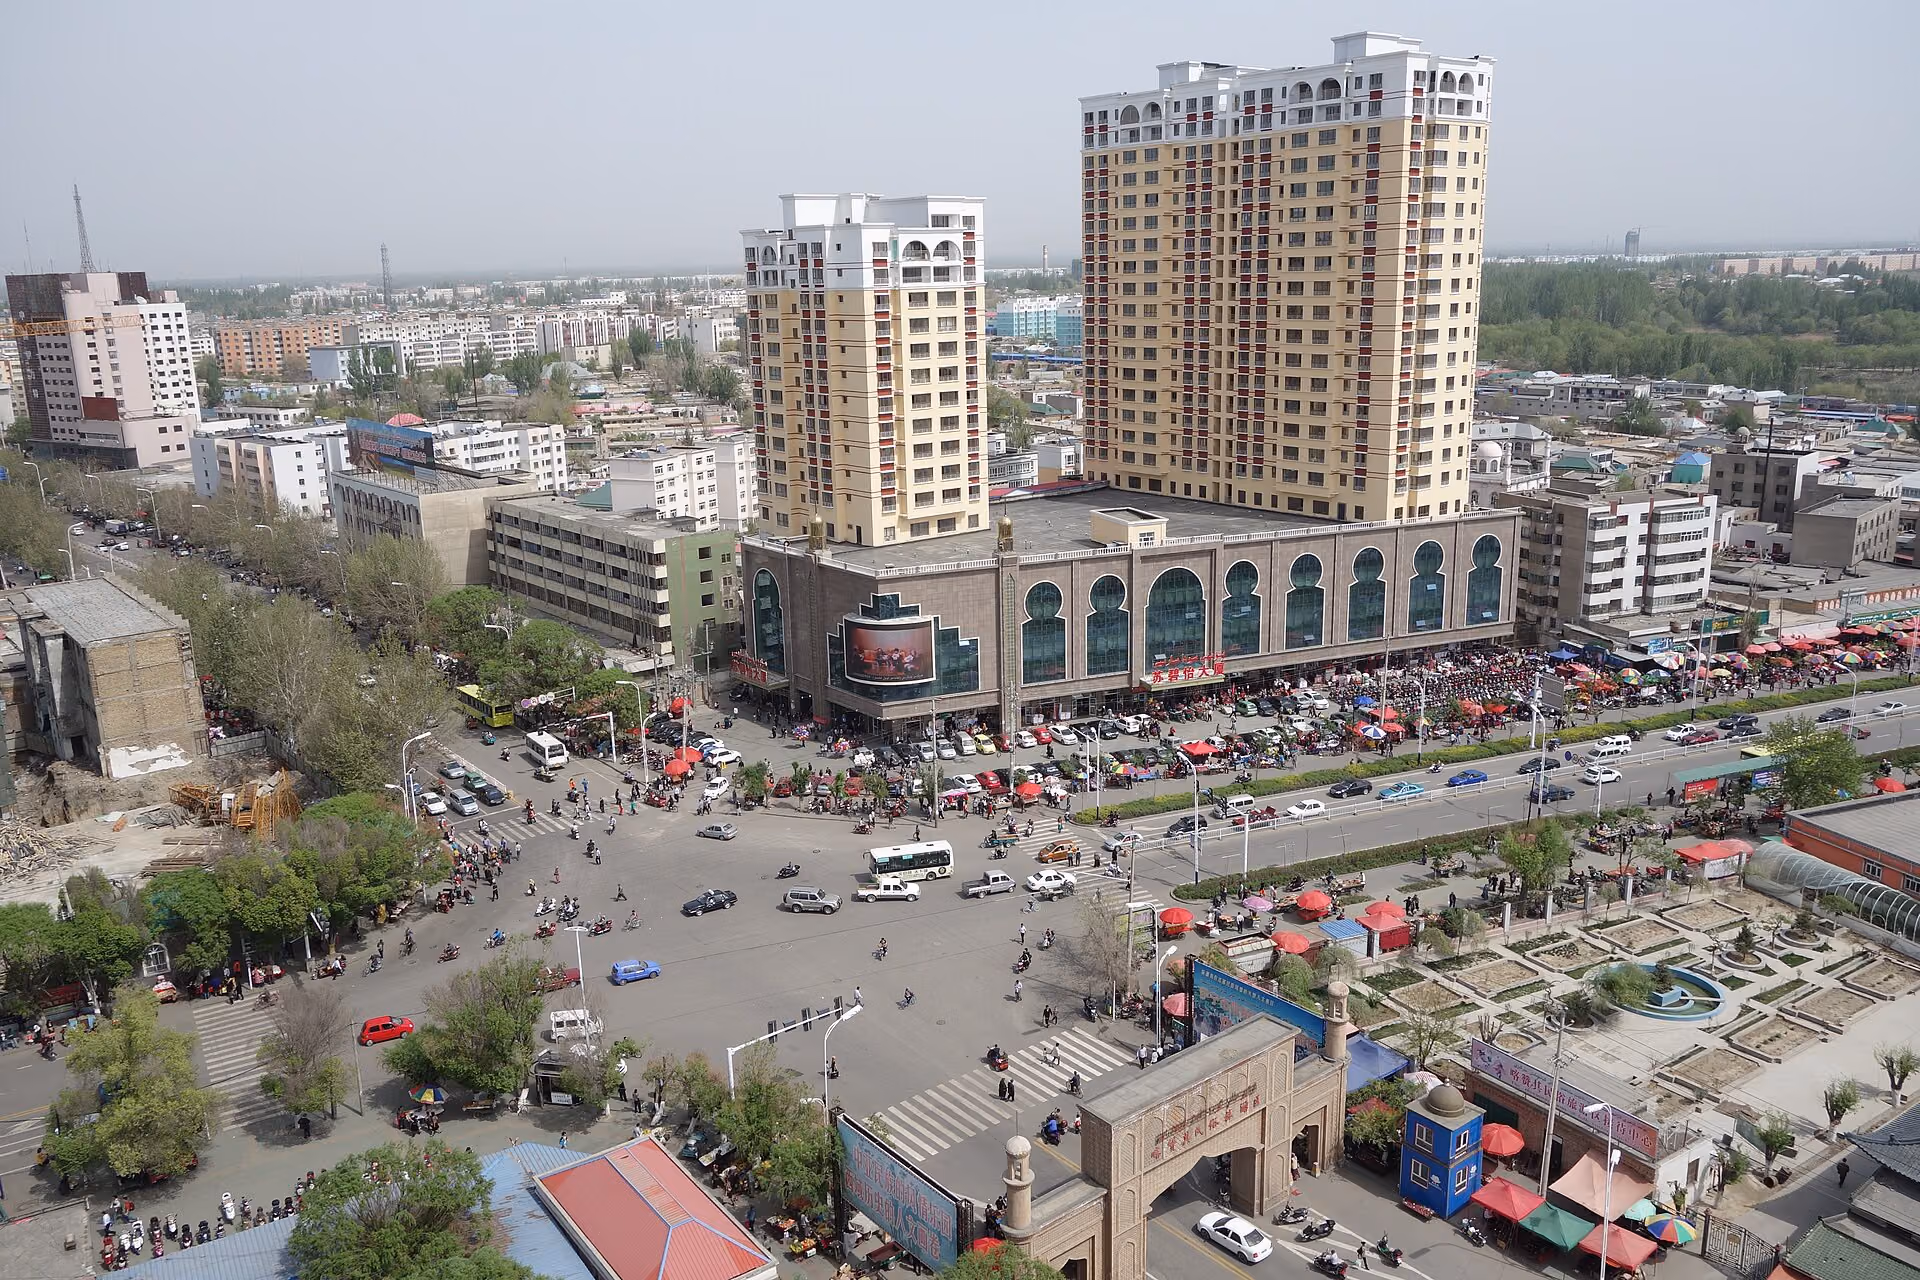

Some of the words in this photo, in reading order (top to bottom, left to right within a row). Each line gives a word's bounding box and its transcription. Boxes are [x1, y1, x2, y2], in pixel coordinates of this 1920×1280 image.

[1152, 662, 1225, 684] 苏碧怡大厦
[853, 1144, 952, 1241] 中亚民族的风情乐园
